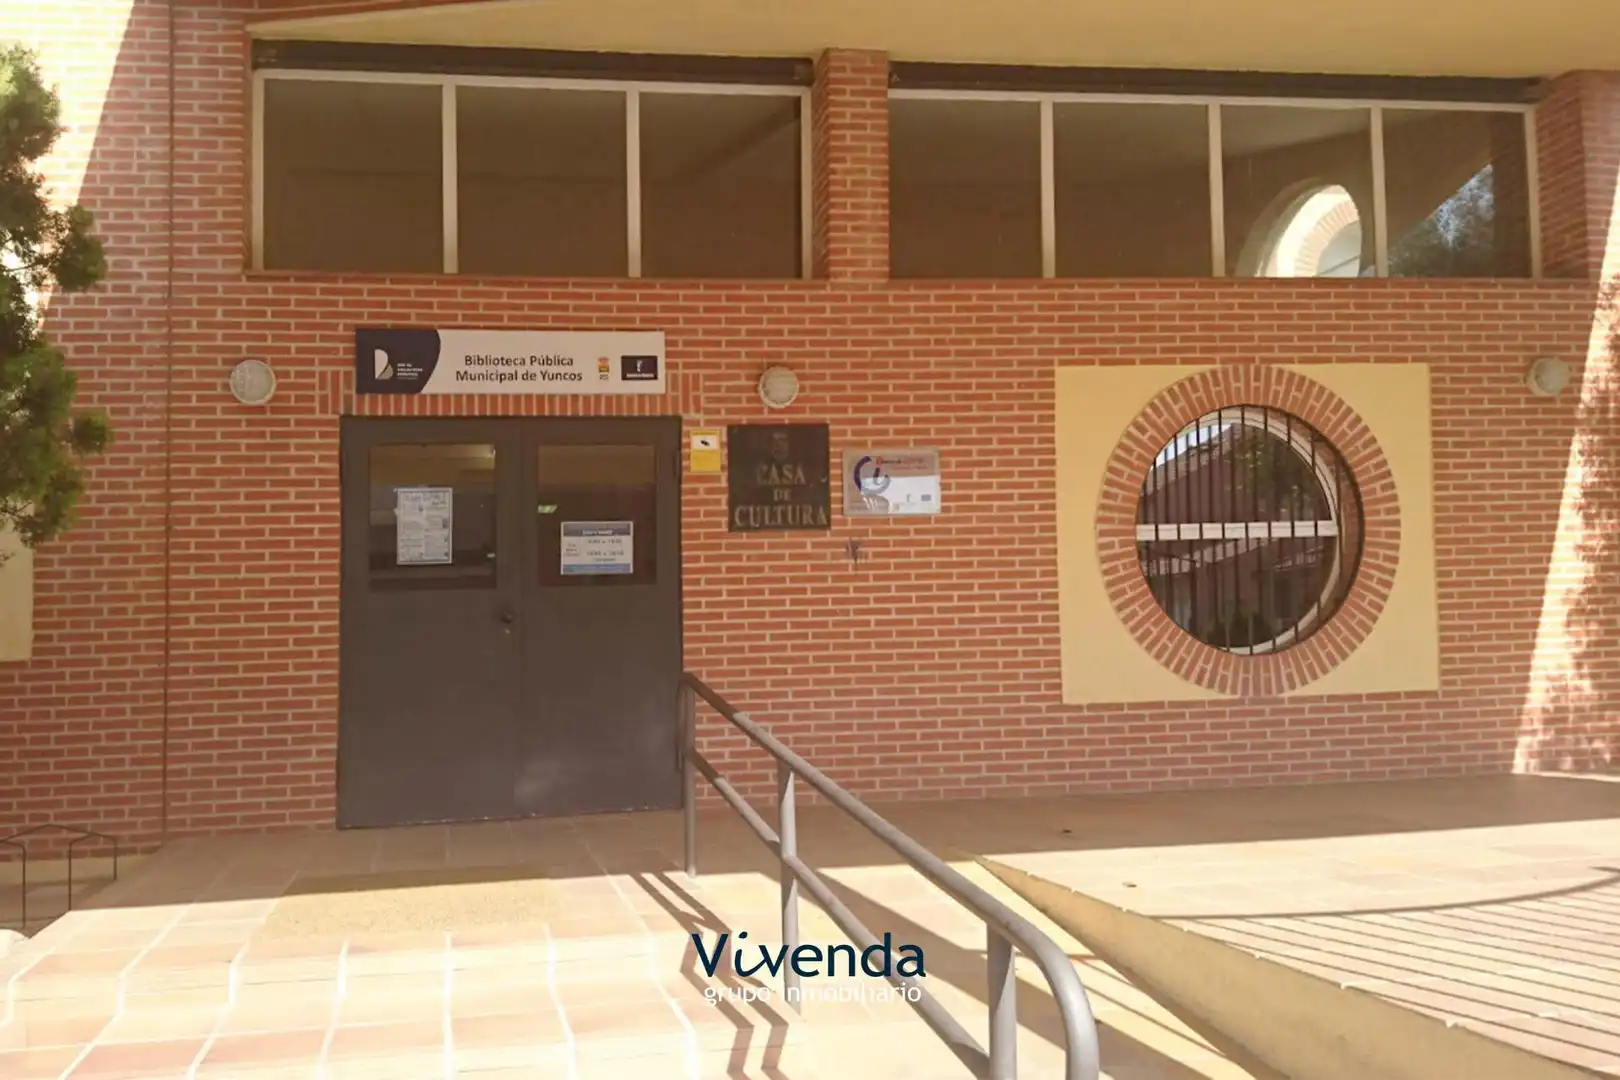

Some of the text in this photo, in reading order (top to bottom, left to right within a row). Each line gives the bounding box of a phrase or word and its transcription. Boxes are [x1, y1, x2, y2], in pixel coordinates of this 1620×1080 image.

[464, 353, 574, 366] Biblioteca Pública
[456, 370, 583, 383] Municipal de Yuncos
[756, 463, 807, 485] CASA
[772, 488, 792, 501] DE
[734, 503, 828, 527] CULTURA
